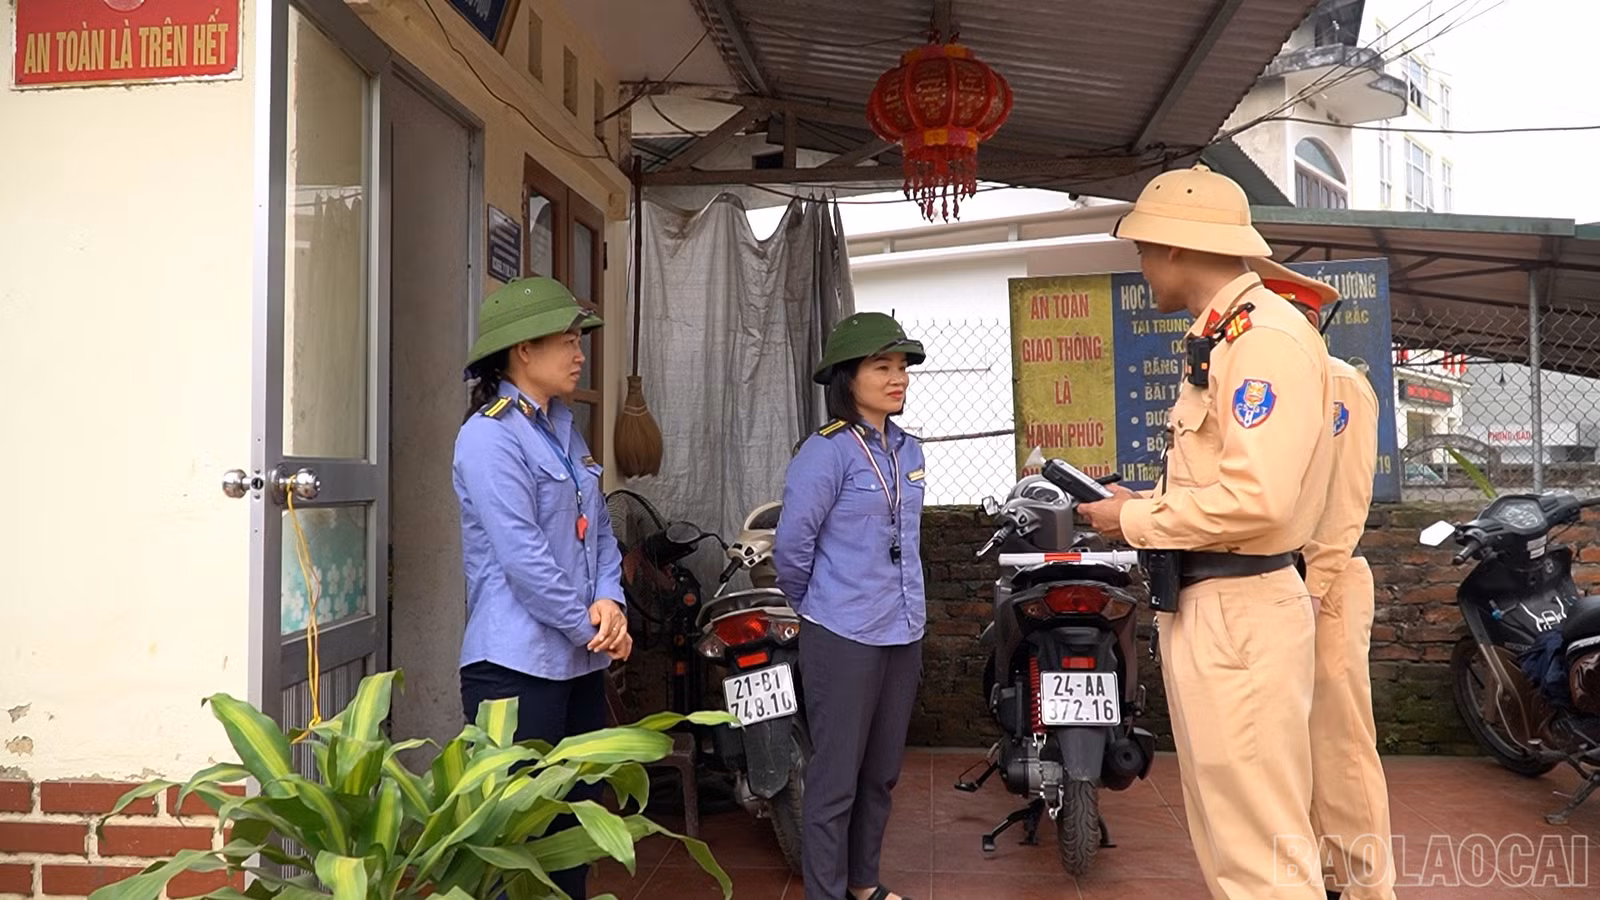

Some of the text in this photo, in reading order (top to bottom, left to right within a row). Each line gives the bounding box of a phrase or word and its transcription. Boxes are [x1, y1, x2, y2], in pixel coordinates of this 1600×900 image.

[24, 8, 229, 74] AN TOÀN LÀ TRÊN HẾT
[1031, 289, 1090, 320] AN TOÀN
[1121, 284, 1146, 315] HỌC
[1132, 320, 1150, 336] TẠI
[1153, 318, 1190, 333] TRUNG
[1022, 332, 1102, 363] GIAO THÔNG
[1055, 375, 1073, 405] LÀ
[1067, 417, 1105, 448] PHÚC
[1053, 675, 1105, 696] 24-AA
[1048, 699, 1114, 721] 372.16
